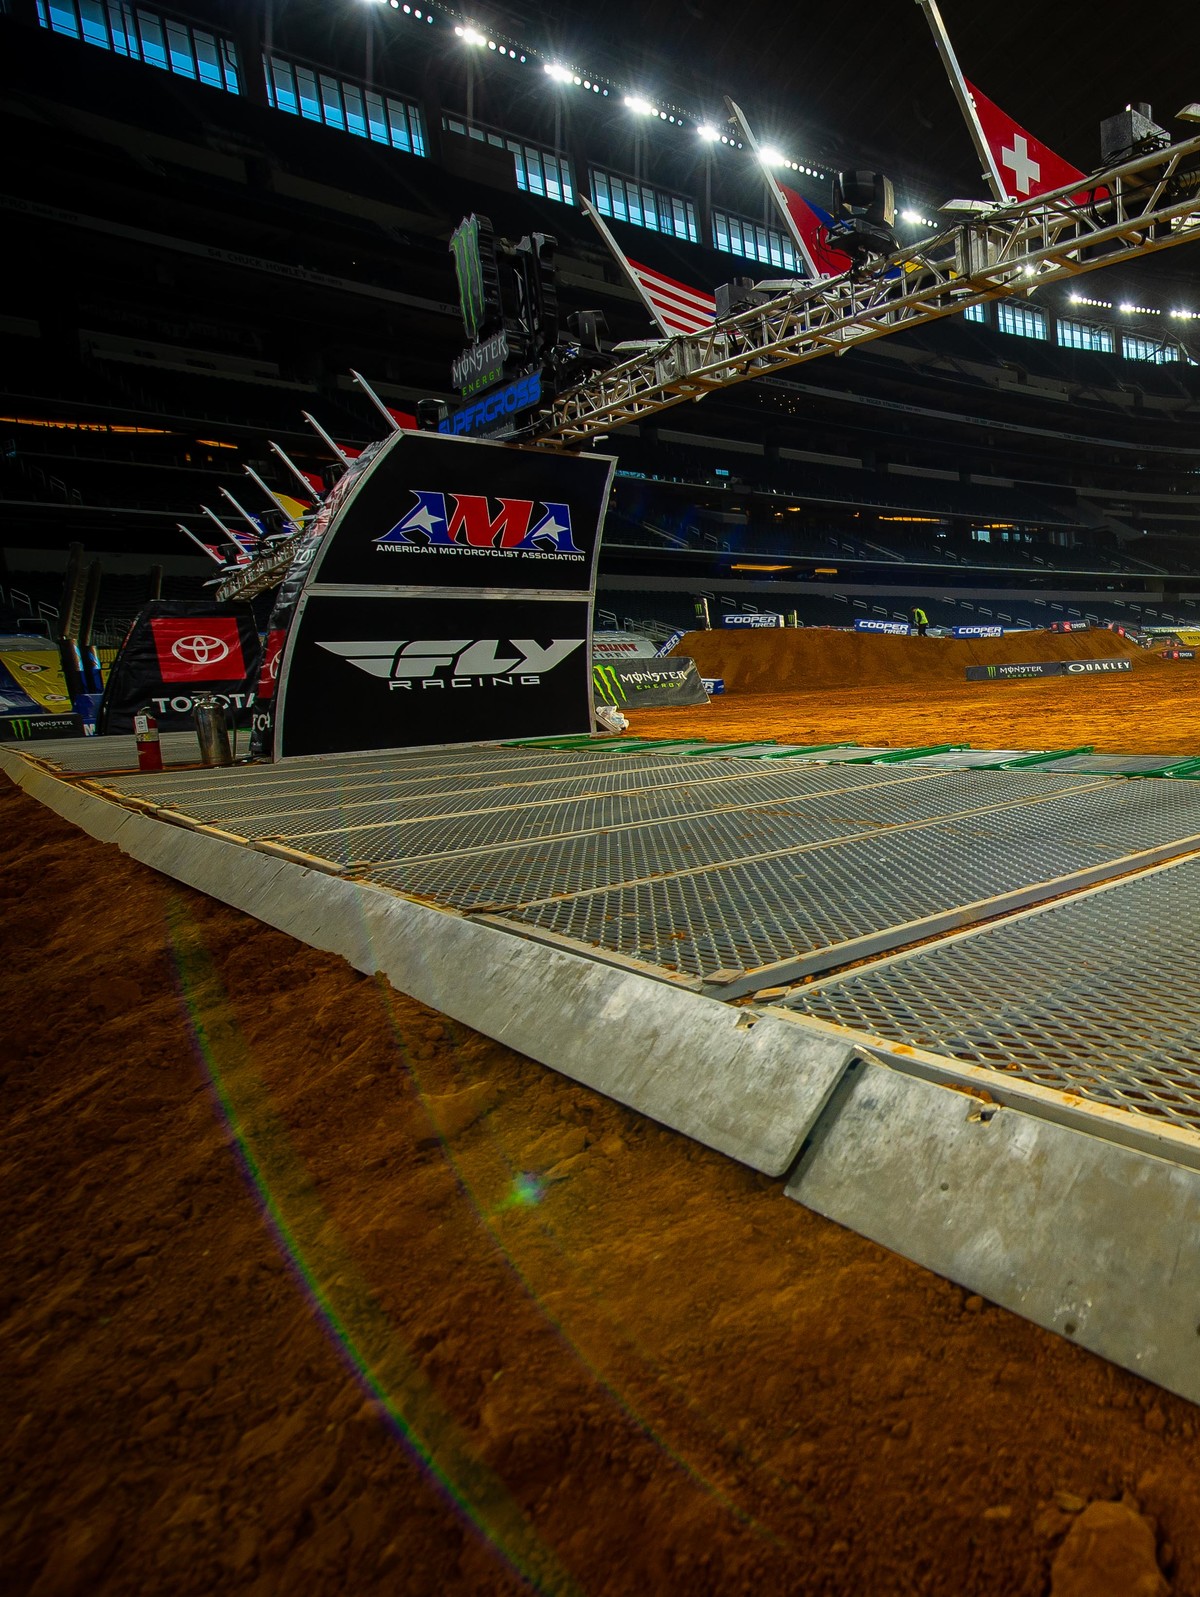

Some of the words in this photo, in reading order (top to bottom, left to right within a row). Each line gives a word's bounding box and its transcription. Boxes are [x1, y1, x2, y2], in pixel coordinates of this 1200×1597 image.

[226, 253, 262, 267] CHUCK
[265, 262, 307, 278] HOWLEY
[453, 335, 507, 383] MONSTER
[461, 367, 502, 398] ENERGY
[438, 372, 541, 436] SUPERCROSS
[371, 489, 586, 554] AMA
[376, 544, 437, 554] AMERICAN
[439, 547, 519, 558] MOTORCYCLIST
[521, 551, 586, 562] ASSOCIATION
[725, 616, 777, 624] COOPER
[858, 620, 909, 632] COOPER
[883, 628, 908, 636] TIRES
[958, 626, 1002, 634] COOPER
[314, 639, 586, 678] FLY
[1000, 665, 1043, 674] MONSTER
[1086, 661, 1130, 672] OAKLEY
[389, 675, 541, 690] RACING
[620, 669, 687, 684] MONSTER
[636, 682, 681, 690] ENERGY
[31, 718, 74, 728] MONSTER
